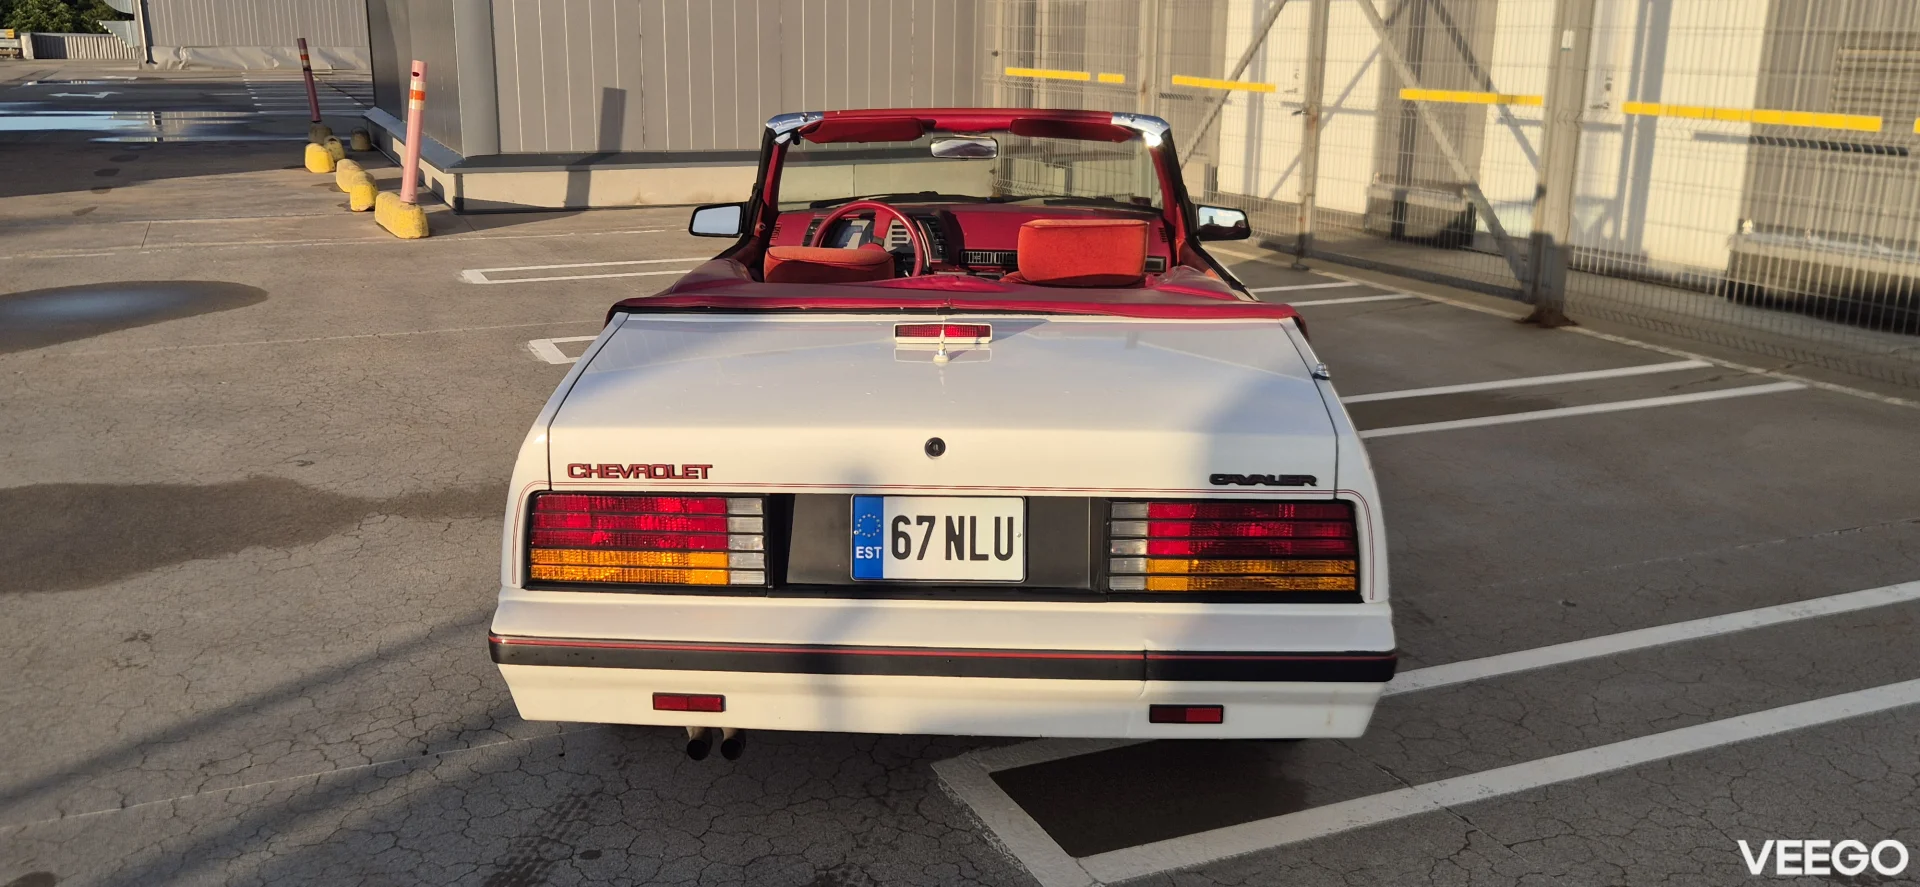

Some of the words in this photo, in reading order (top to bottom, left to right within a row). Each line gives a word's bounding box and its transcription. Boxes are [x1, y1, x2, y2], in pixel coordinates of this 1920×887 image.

[567, 463, 713, 479] CHEVROLET
[891, 514, 936, 560] 67
[945, 515, 1014, 561] NLU
[855, 546, 882, 559] EST
